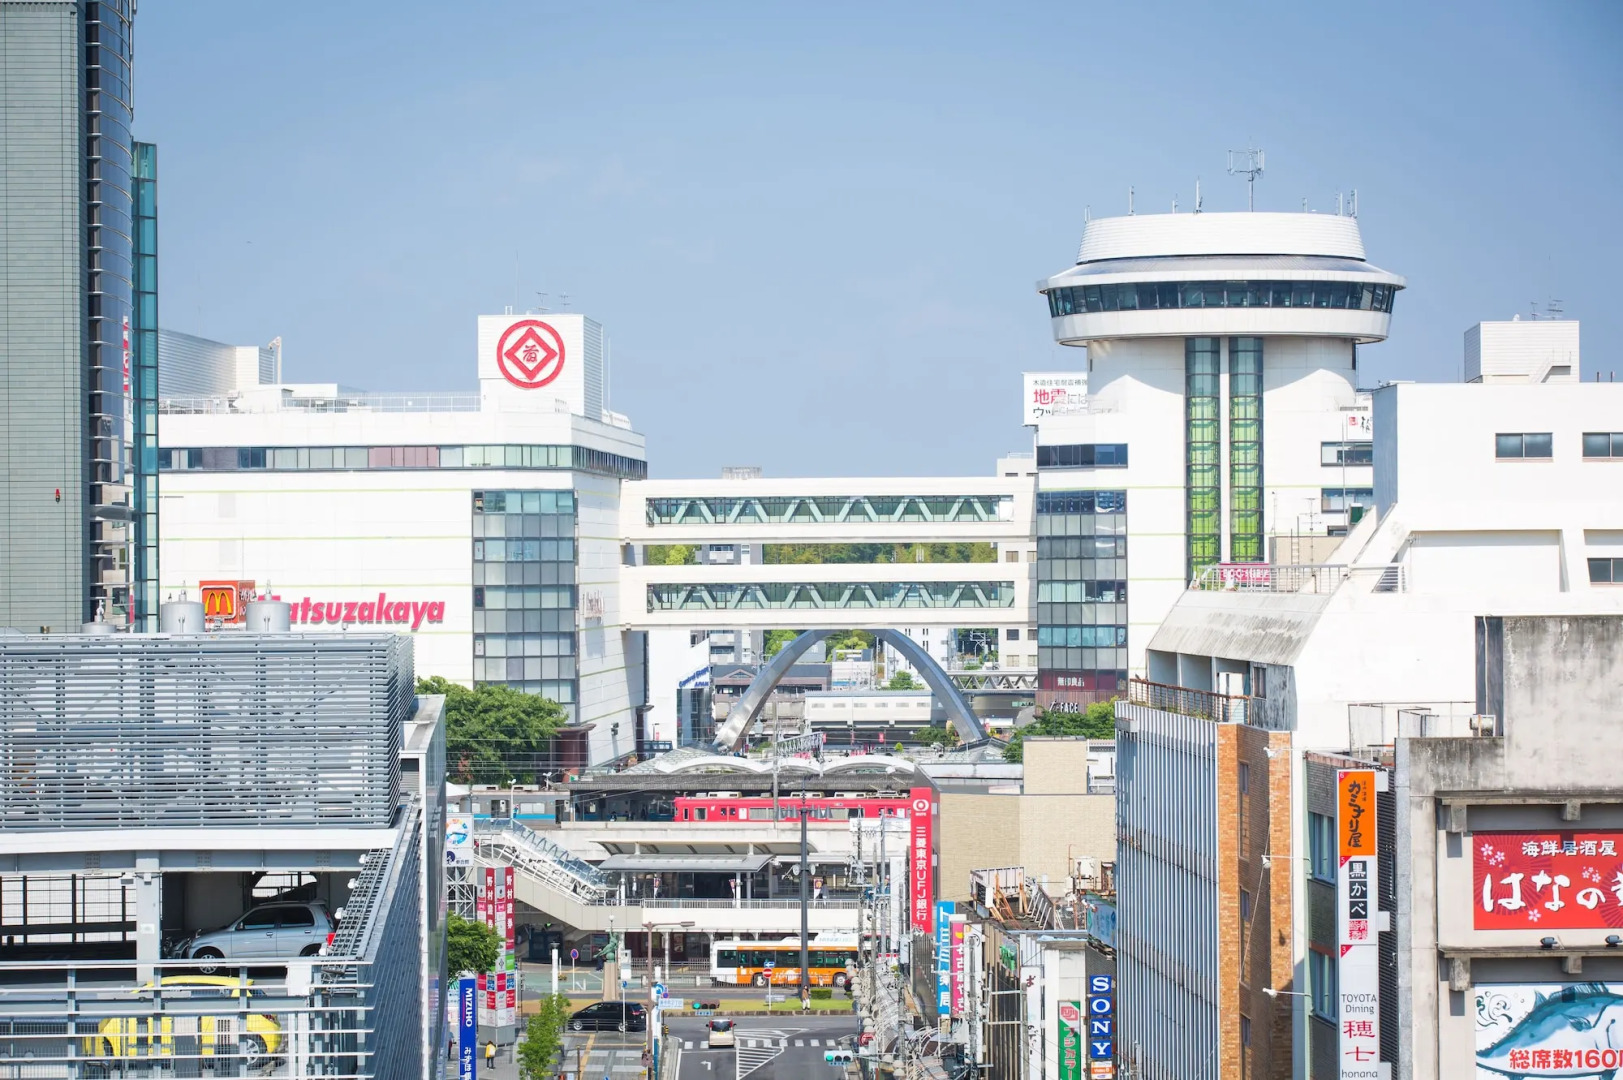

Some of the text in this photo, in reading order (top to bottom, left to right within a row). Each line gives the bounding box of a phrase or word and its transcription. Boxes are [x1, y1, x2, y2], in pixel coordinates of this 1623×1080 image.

[258, 593, 445, 631] atsuzakaya
[1522, 840, 1618, 857] 海鮮居酒屋
[1349, 862, 1367, 916] 黒かべ
[465, 987, 473, 1028] MIZUHO
[1341, 994, 1377, 1003] TOYOTA
[1345, 1004, 1375, 1015] Dining
[1092, 976, 1110, 1056] SONY
[1343, 1020, 1376, 1062] 穂七
[1341, 1070, 1378, 1079] honana
[1510, 1050, 1623, 1070] 総席数160
